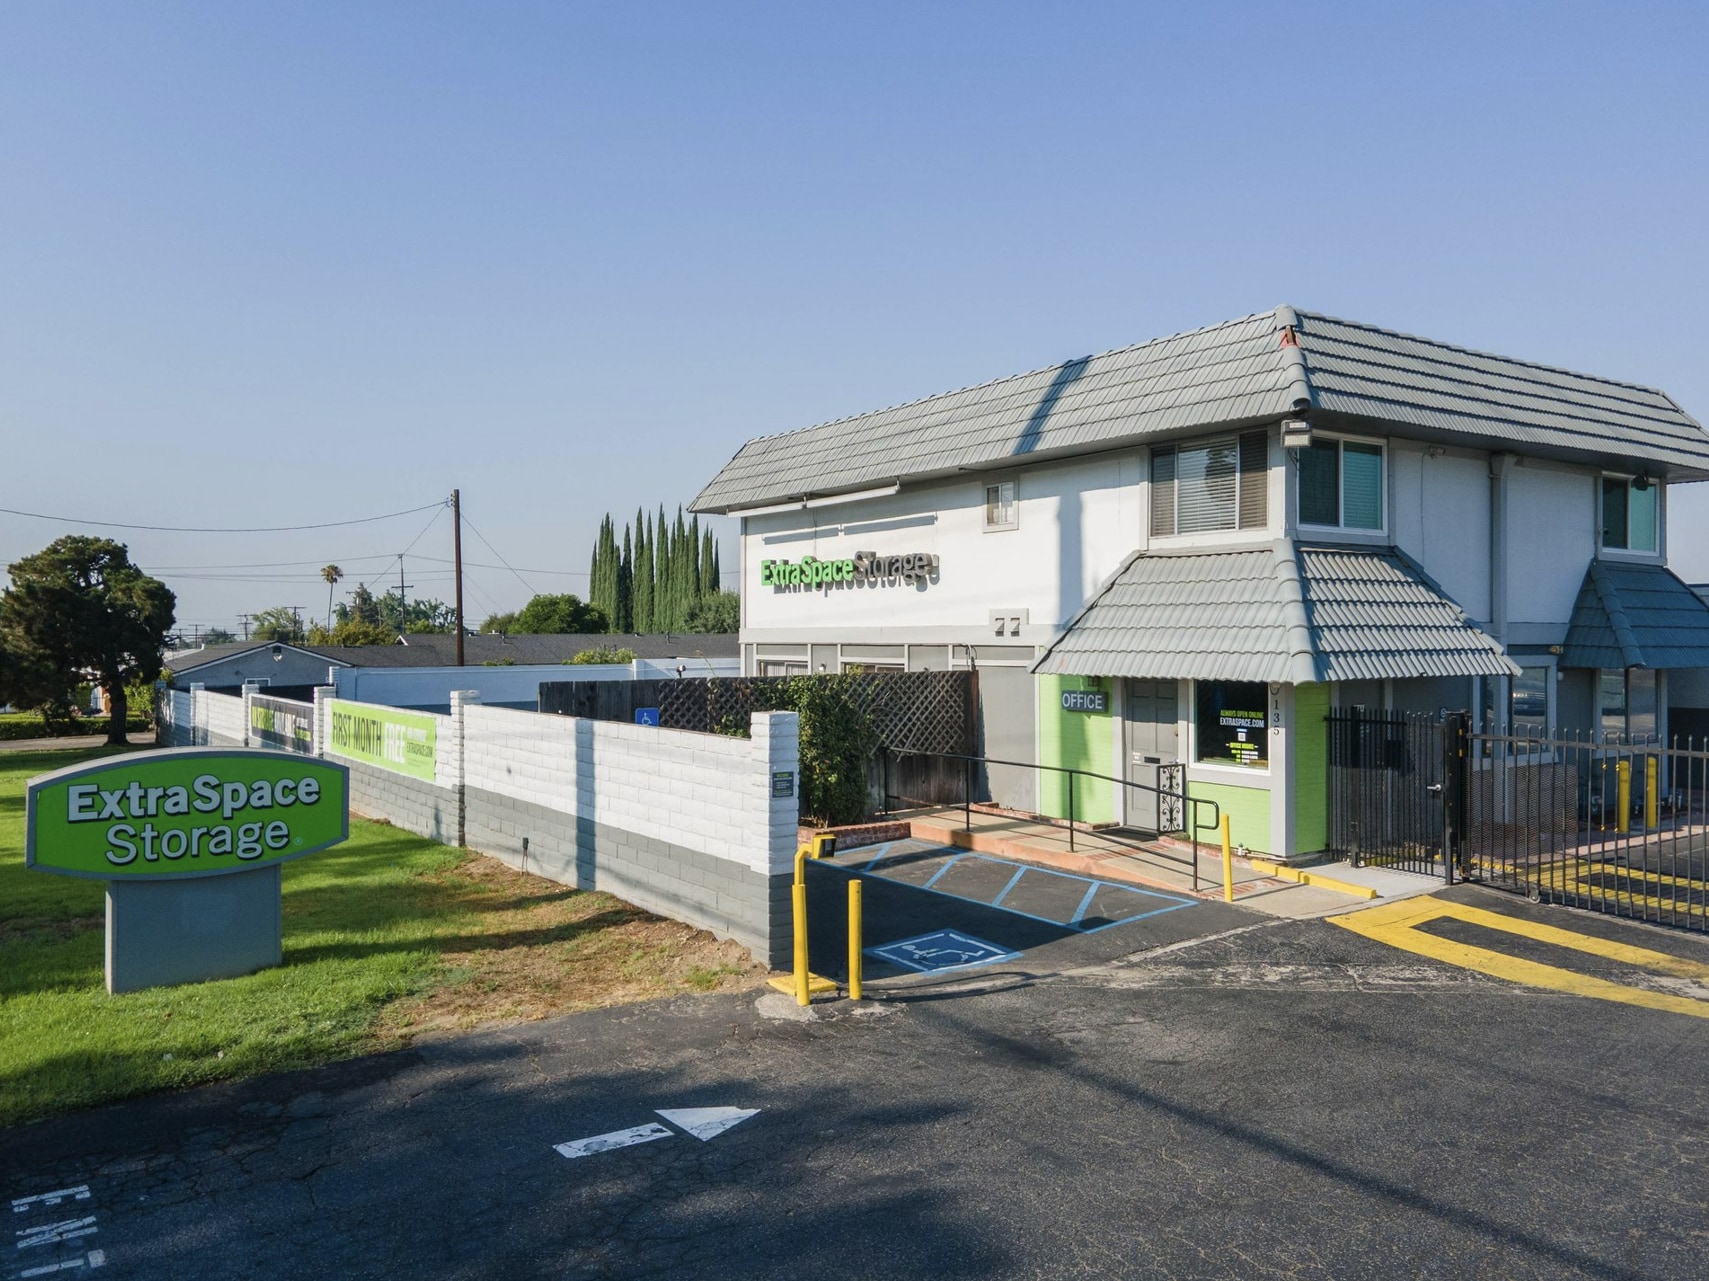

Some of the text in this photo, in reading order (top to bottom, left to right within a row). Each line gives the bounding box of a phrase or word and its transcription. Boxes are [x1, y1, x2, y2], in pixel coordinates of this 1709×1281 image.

[1062, 692, 1103, 710] OFFICE
[332, 712, 351, 748] FIRST
[354, 716, 382, 757] MONTH
[384, 722, 406, 764] FREE
[1220, 717, 1265, 728] EXTRASPACE.COM
[105, 818, 290, 865] Storage
